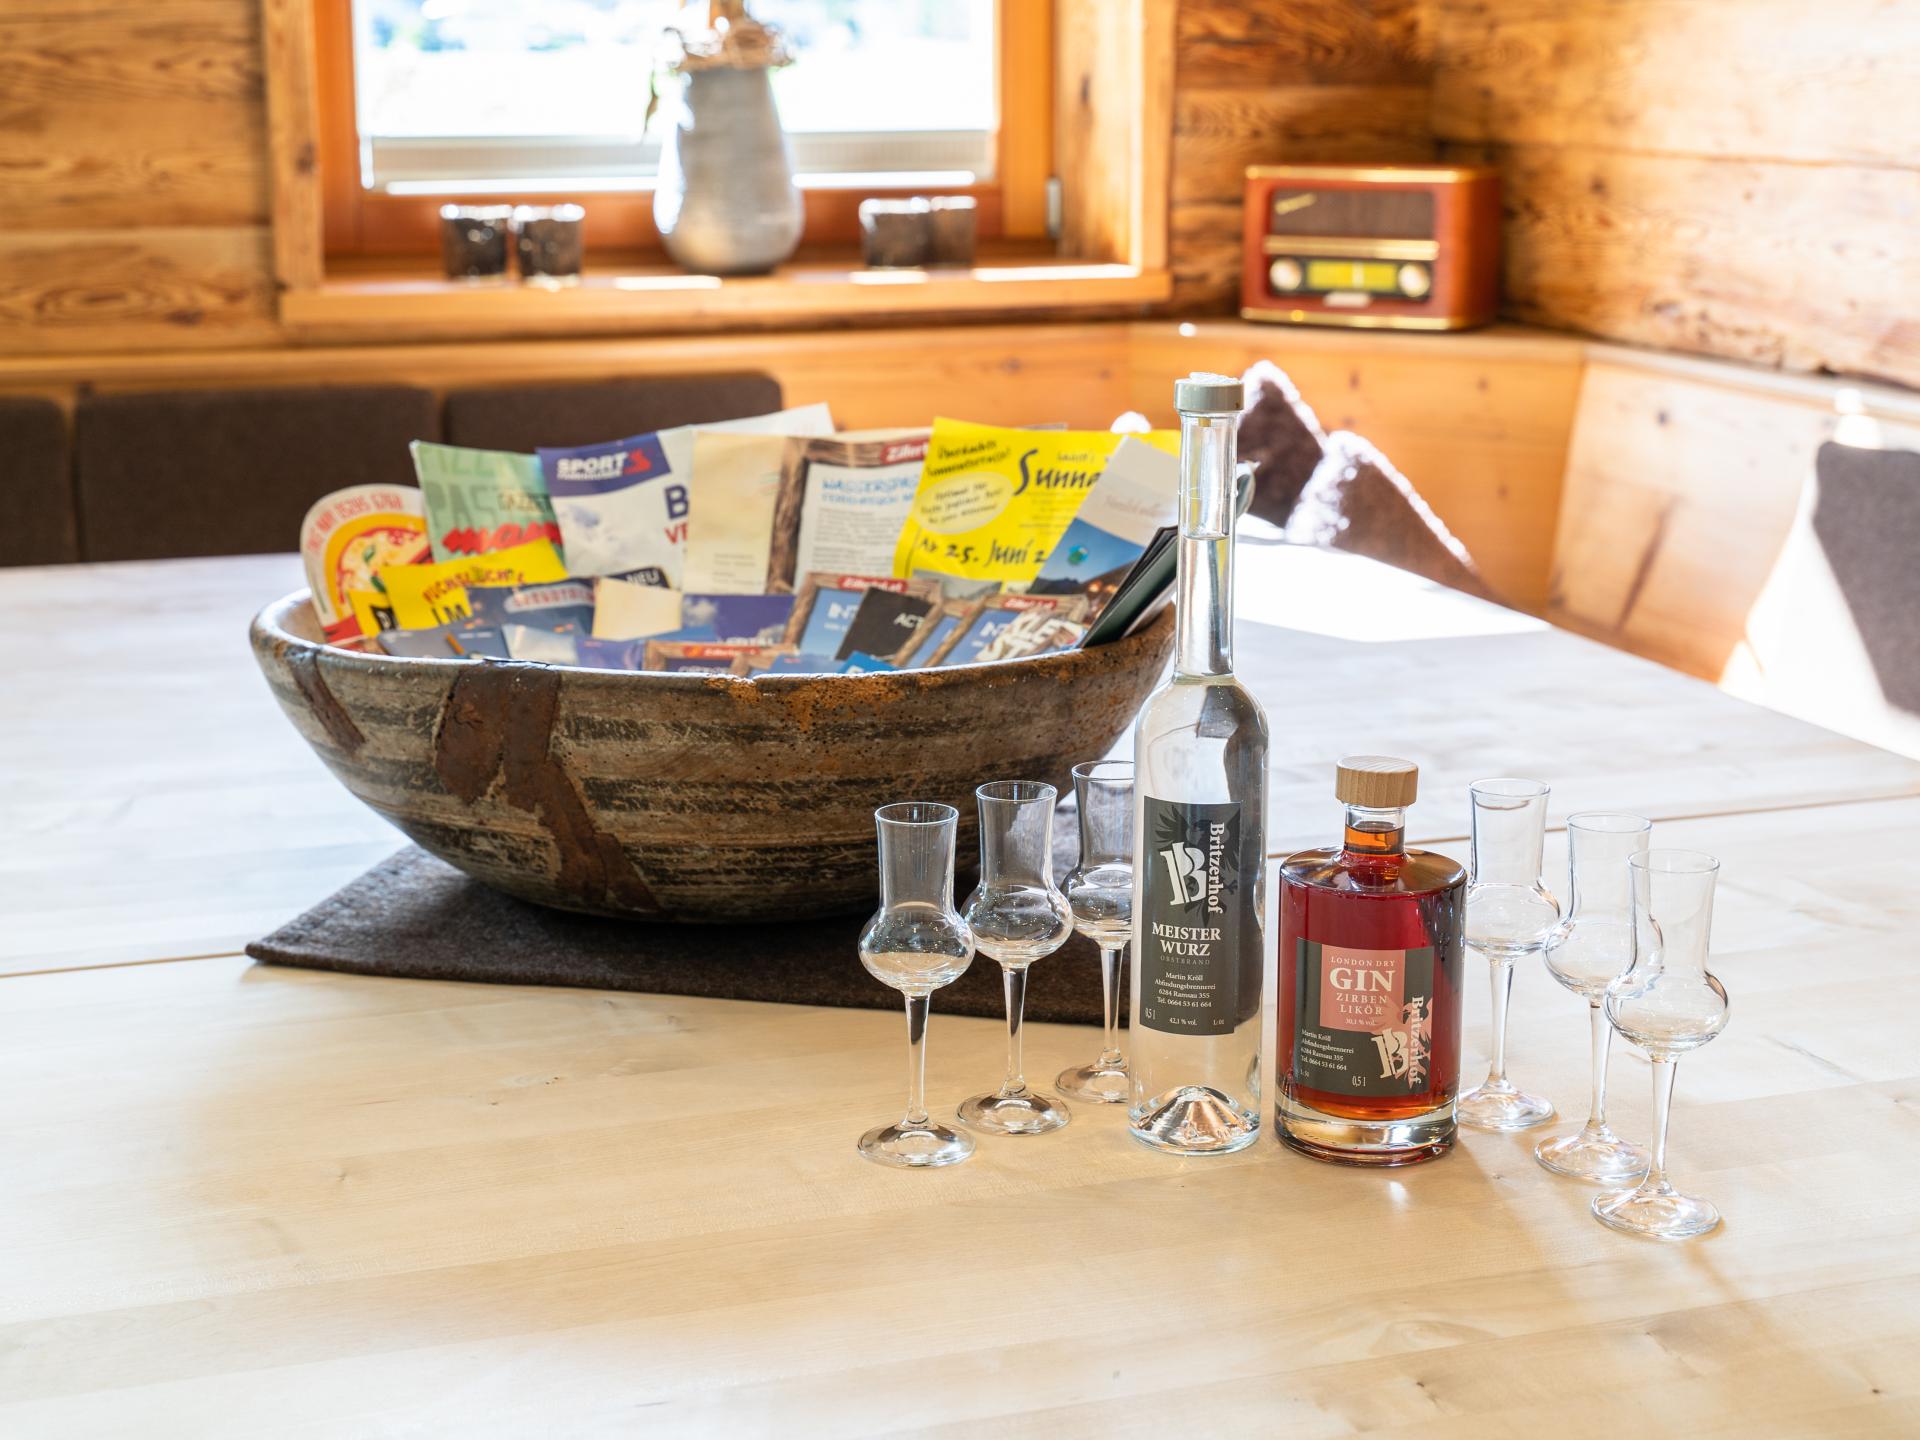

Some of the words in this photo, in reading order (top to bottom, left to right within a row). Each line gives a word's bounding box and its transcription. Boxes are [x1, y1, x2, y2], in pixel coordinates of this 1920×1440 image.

[557, 452, 629, 475] SPORT
[664, 484, 689, 520] B
[944, 543, 979, 564] 25.
[893, 612, 925, 629] ACT
[1207, 822, 1224, 914] Britzerhof
[1152, 921, 1221, 941] MEISTER
[1160, 939, 1211, 956] WURZ
[1331, 956, 1373, 967] LONDON
[1376, 959, 1396, 967] DRY
[1165, 971, 1186, 980] Martin
[1329, 967, 1396, 992] GIN
[1154, 978, 1216, 990] Abfindungsbrennerei
[1158, 988, 1172, 996] 6284
[1173, 991, 1198, 999] Ramsau
[1336, 992, 1387, 1004] ZIRBEN
[1157, 996, 1166, 1004] Tel.
[1167, 998, 1182, 1007] 0664
[1340, 1004, 1383, 1015] LIKÖR
[1169, 1017, 1180, 1025] 42,1
[1301, 1028, 1318, 1039] Martin
[1409, 996, 1424, 1084] Britzerhof
[1301, 1037, 1354, 1054] Abfindungsbrennerei
[1312, 1049, 1333, 1060] Ramsau
[1333, 1054, 1344, 1062] 355
[1309, 1057, 1321, 1066] 0664
[1321, 1060, 1328, 1068] 53
[1336, 1063, 1347, 1071] 664
[1352, 1075, 1361, 1087] 0,5
